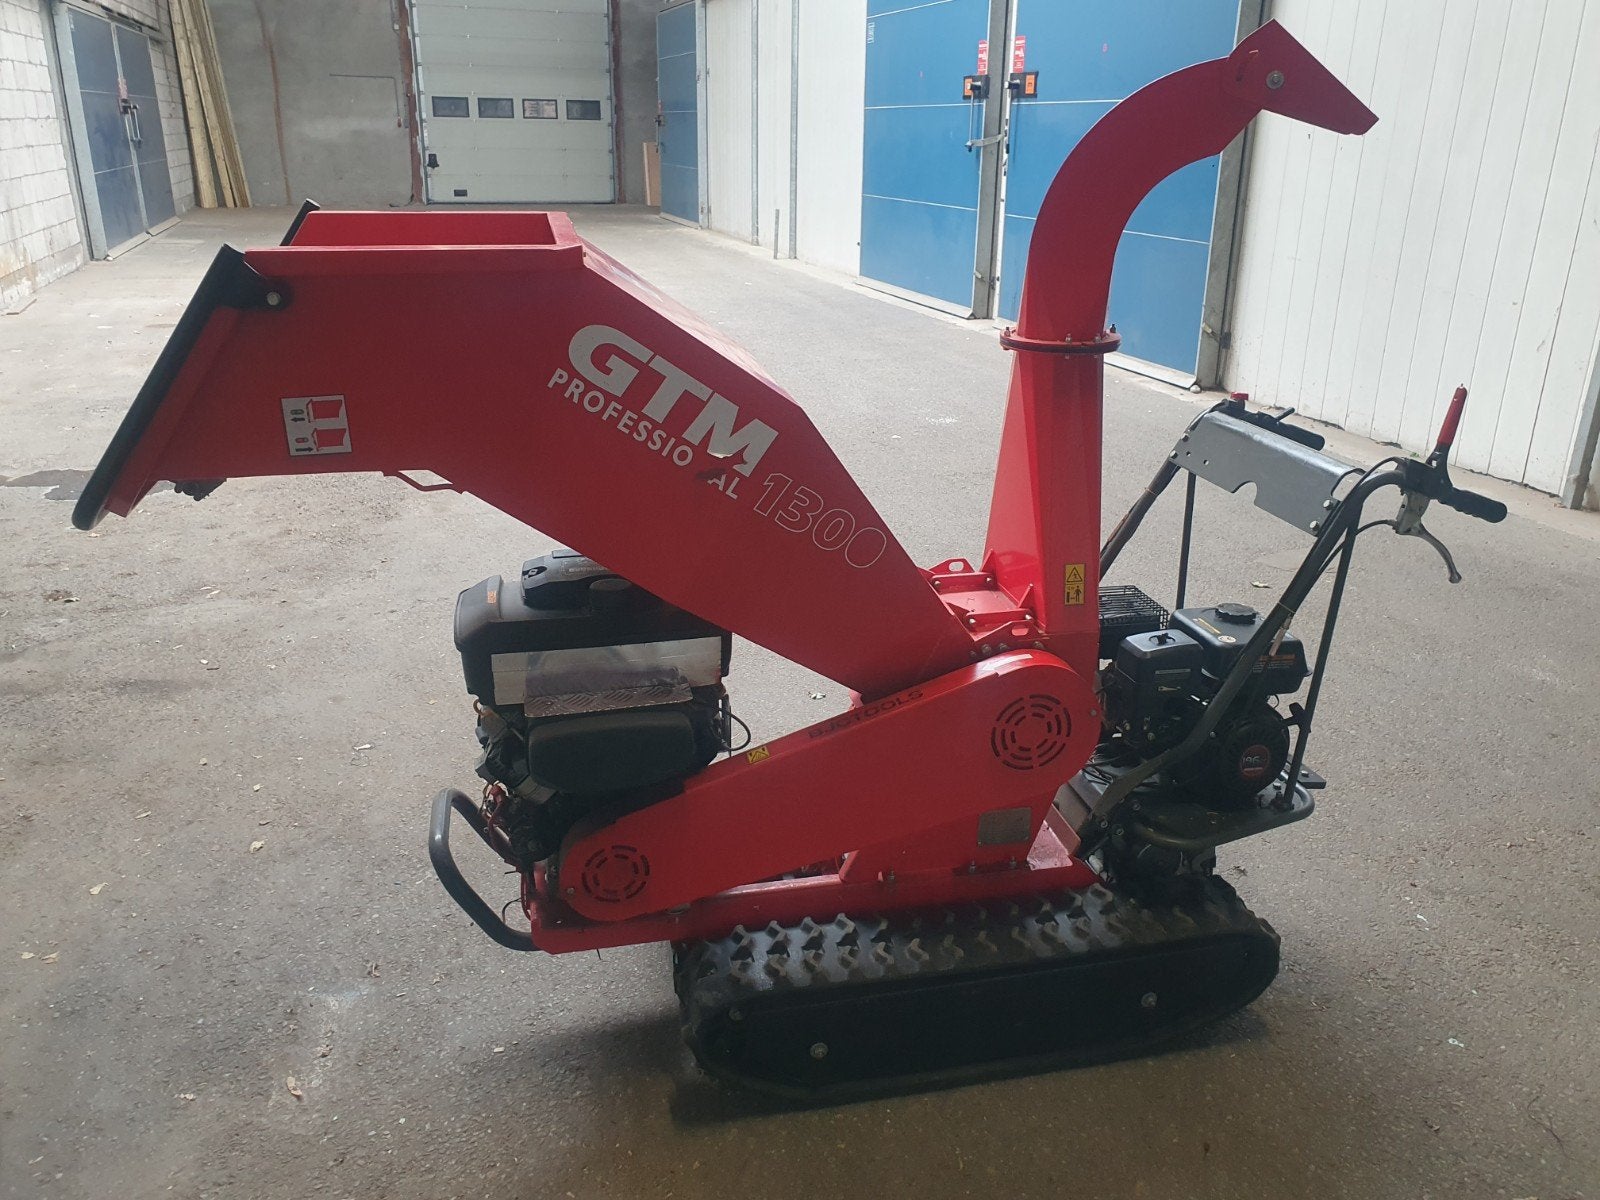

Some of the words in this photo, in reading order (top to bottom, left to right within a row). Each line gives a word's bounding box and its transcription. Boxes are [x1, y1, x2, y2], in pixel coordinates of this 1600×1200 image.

[547, 368, 738, 500] PROFESSIOAL
[568, 324, 779, 477] GTM
[753, 472, 887, 568] 1300
